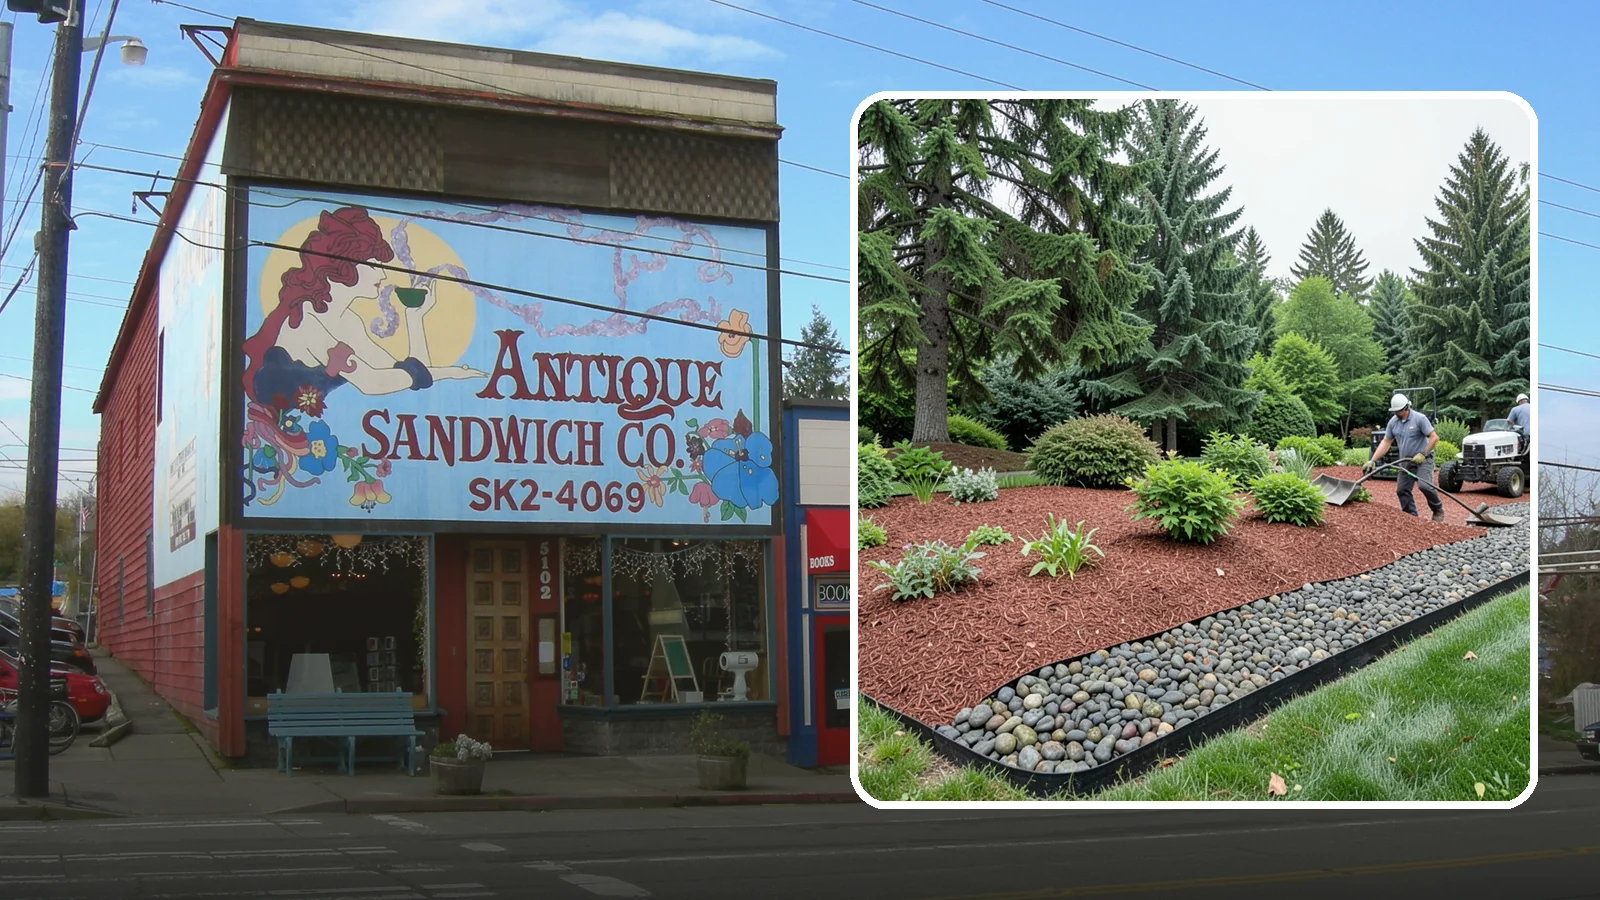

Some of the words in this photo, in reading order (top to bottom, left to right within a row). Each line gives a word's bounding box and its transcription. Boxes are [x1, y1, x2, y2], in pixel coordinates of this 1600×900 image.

[476, 329, 723, 420] ANTIQUE
[360, 408, 604, 467] SANDWICH
[617, 421, 686, 469] CO.
[467, 476, 647, 513] SK2-4069
[540, 541, 552, 600] 5102
[809, 555, 835, 569] BOOKS
